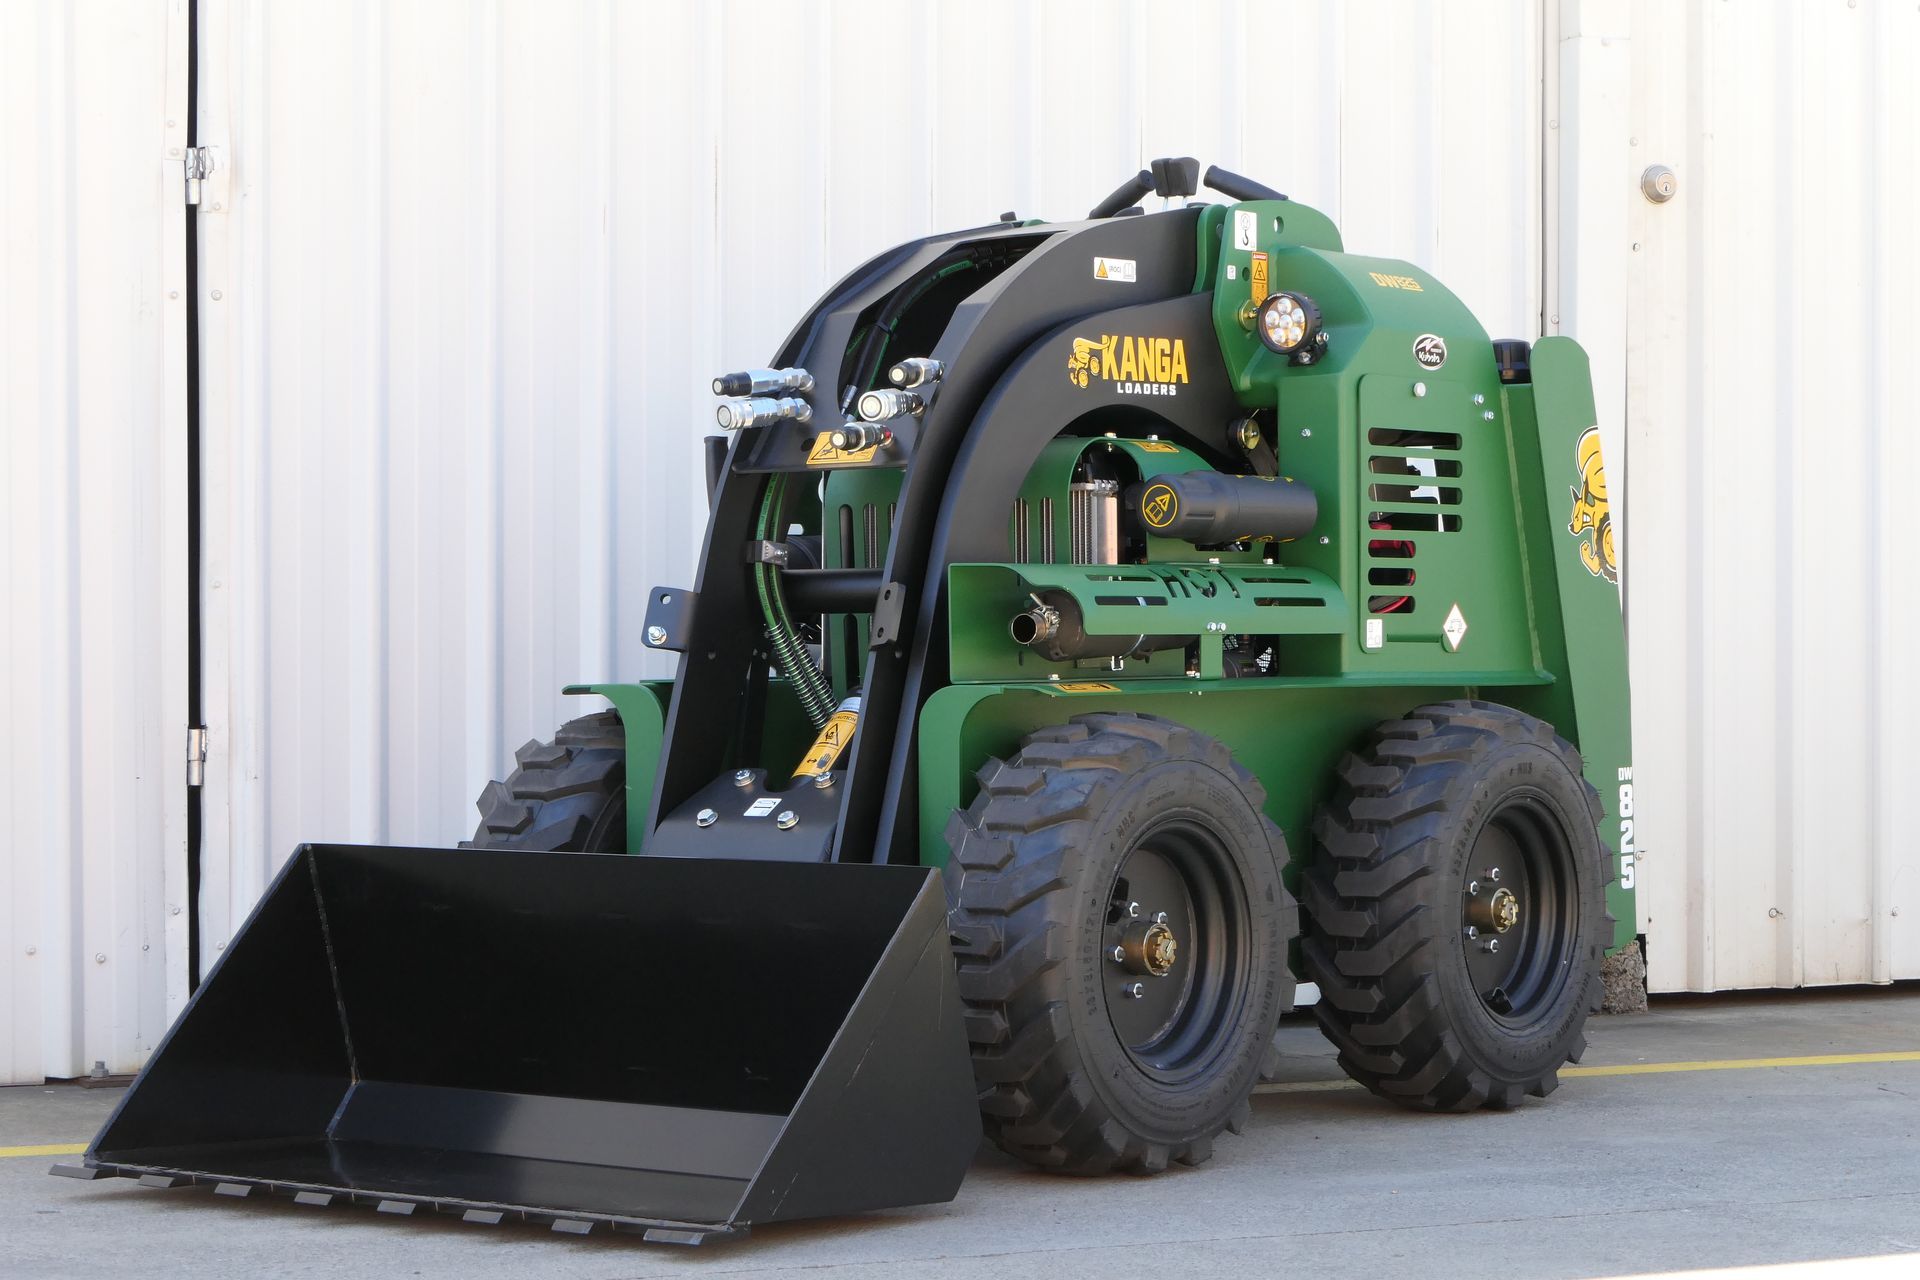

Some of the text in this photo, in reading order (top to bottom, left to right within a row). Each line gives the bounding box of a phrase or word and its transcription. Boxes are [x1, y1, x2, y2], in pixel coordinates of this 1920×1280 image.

[1101, 335, 1189, 384] KANGA
[1117, 382, 1177, 396] LOADERS
[1148, 567, 1241, 598] HOT
[1618, 766, 1635, 890] DW 825
